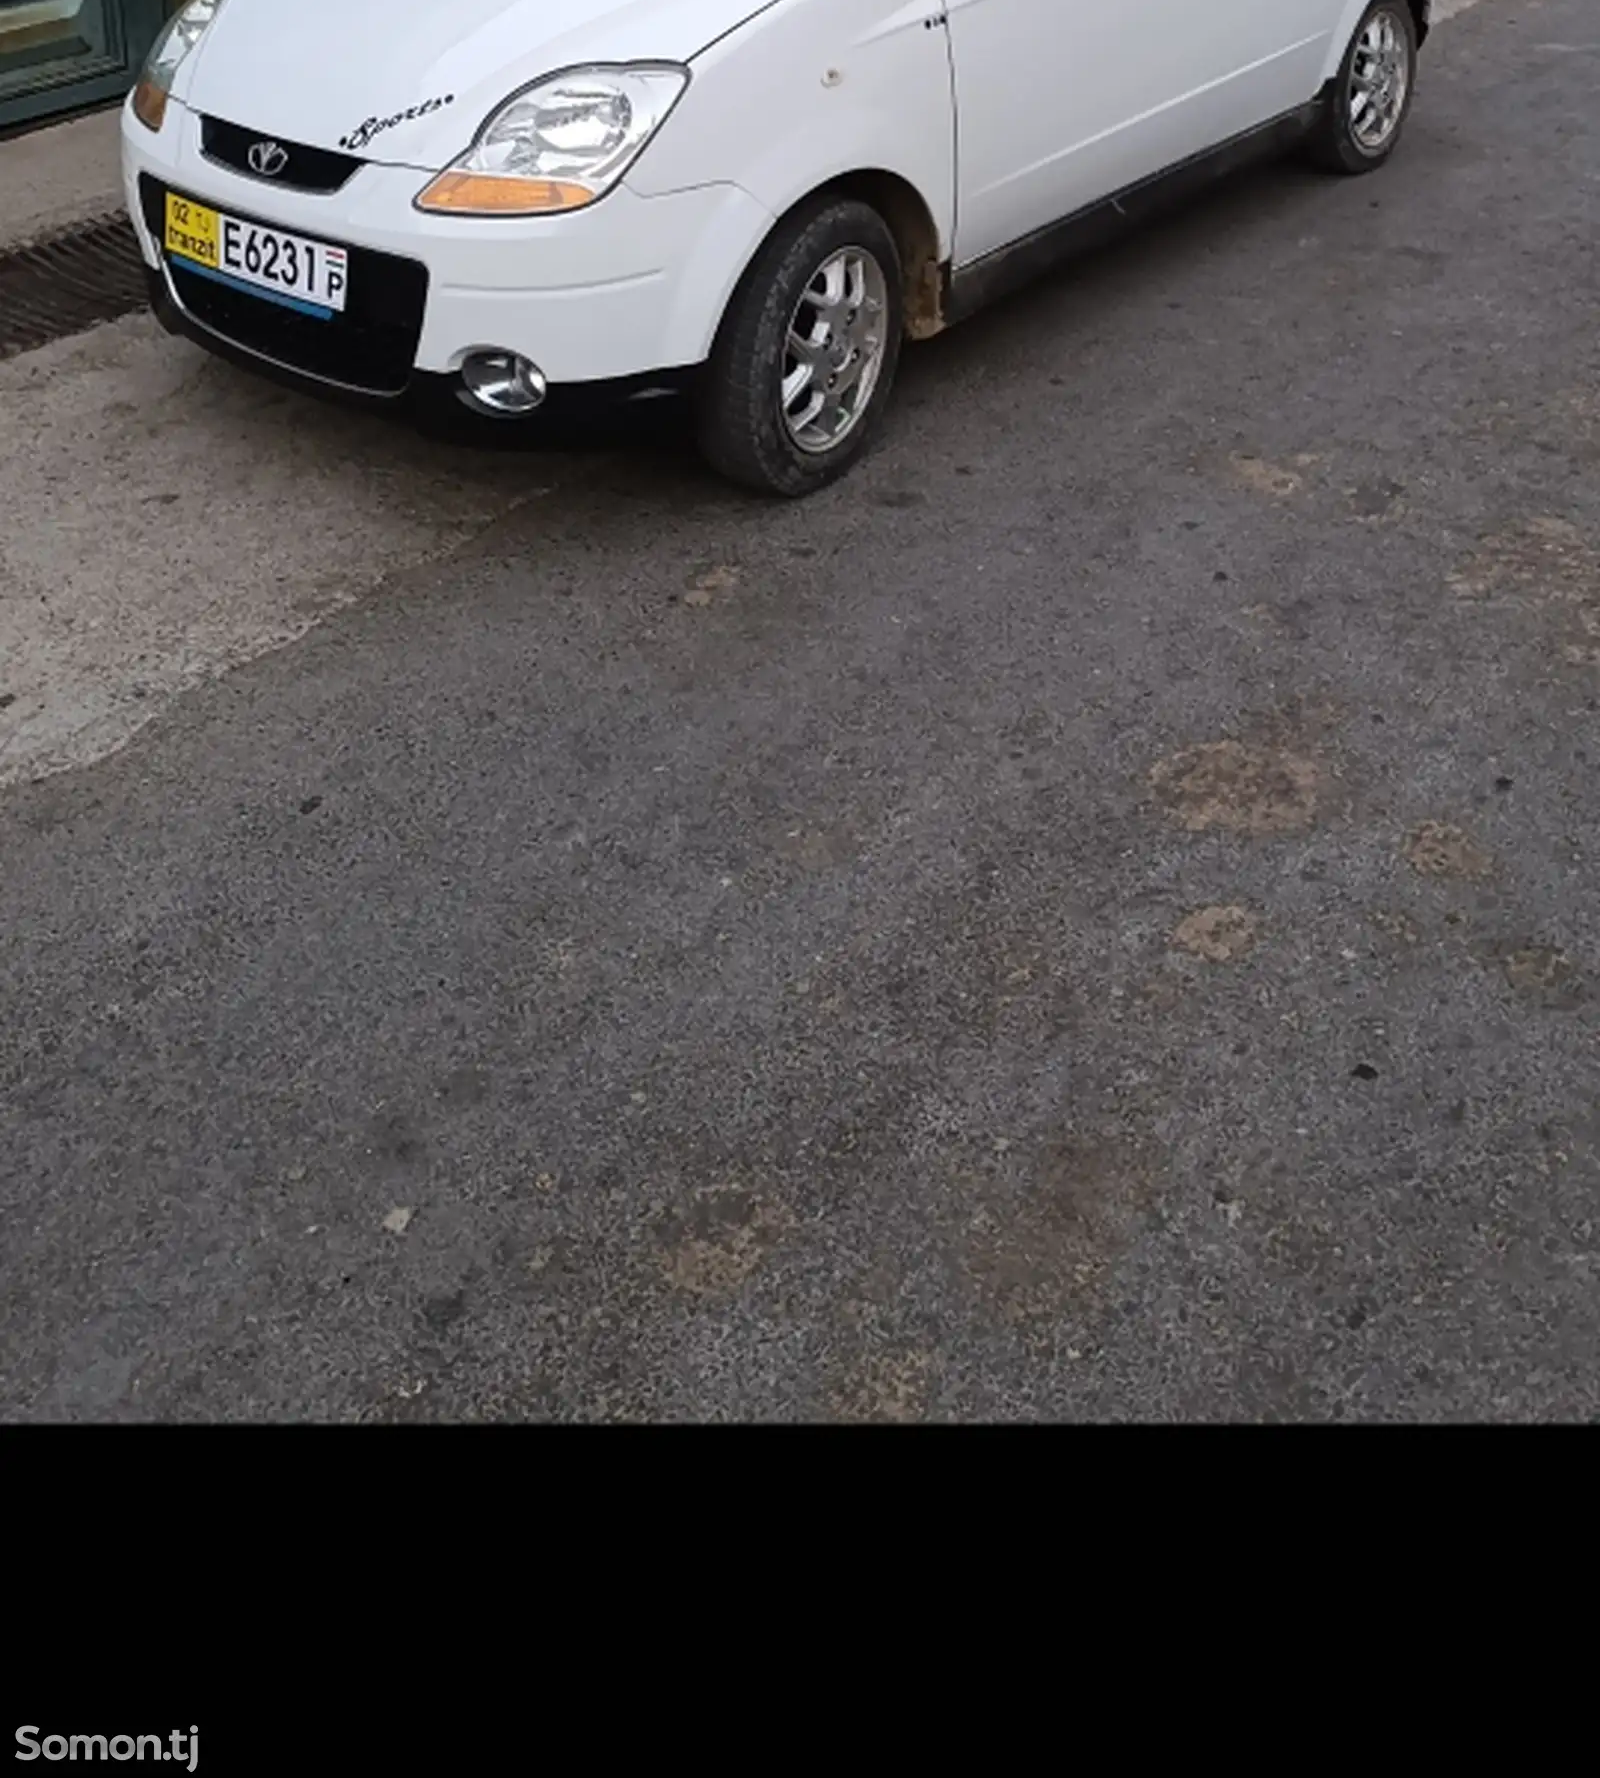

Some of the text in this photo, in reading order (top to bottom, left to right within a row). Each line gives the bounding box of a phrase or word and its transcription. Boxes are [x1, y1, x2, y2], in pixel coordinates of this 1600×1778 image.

[171, 199, 190, 226] 02
[222, 218, 316, 292] E6231
[326, 270, 344, 299] P
